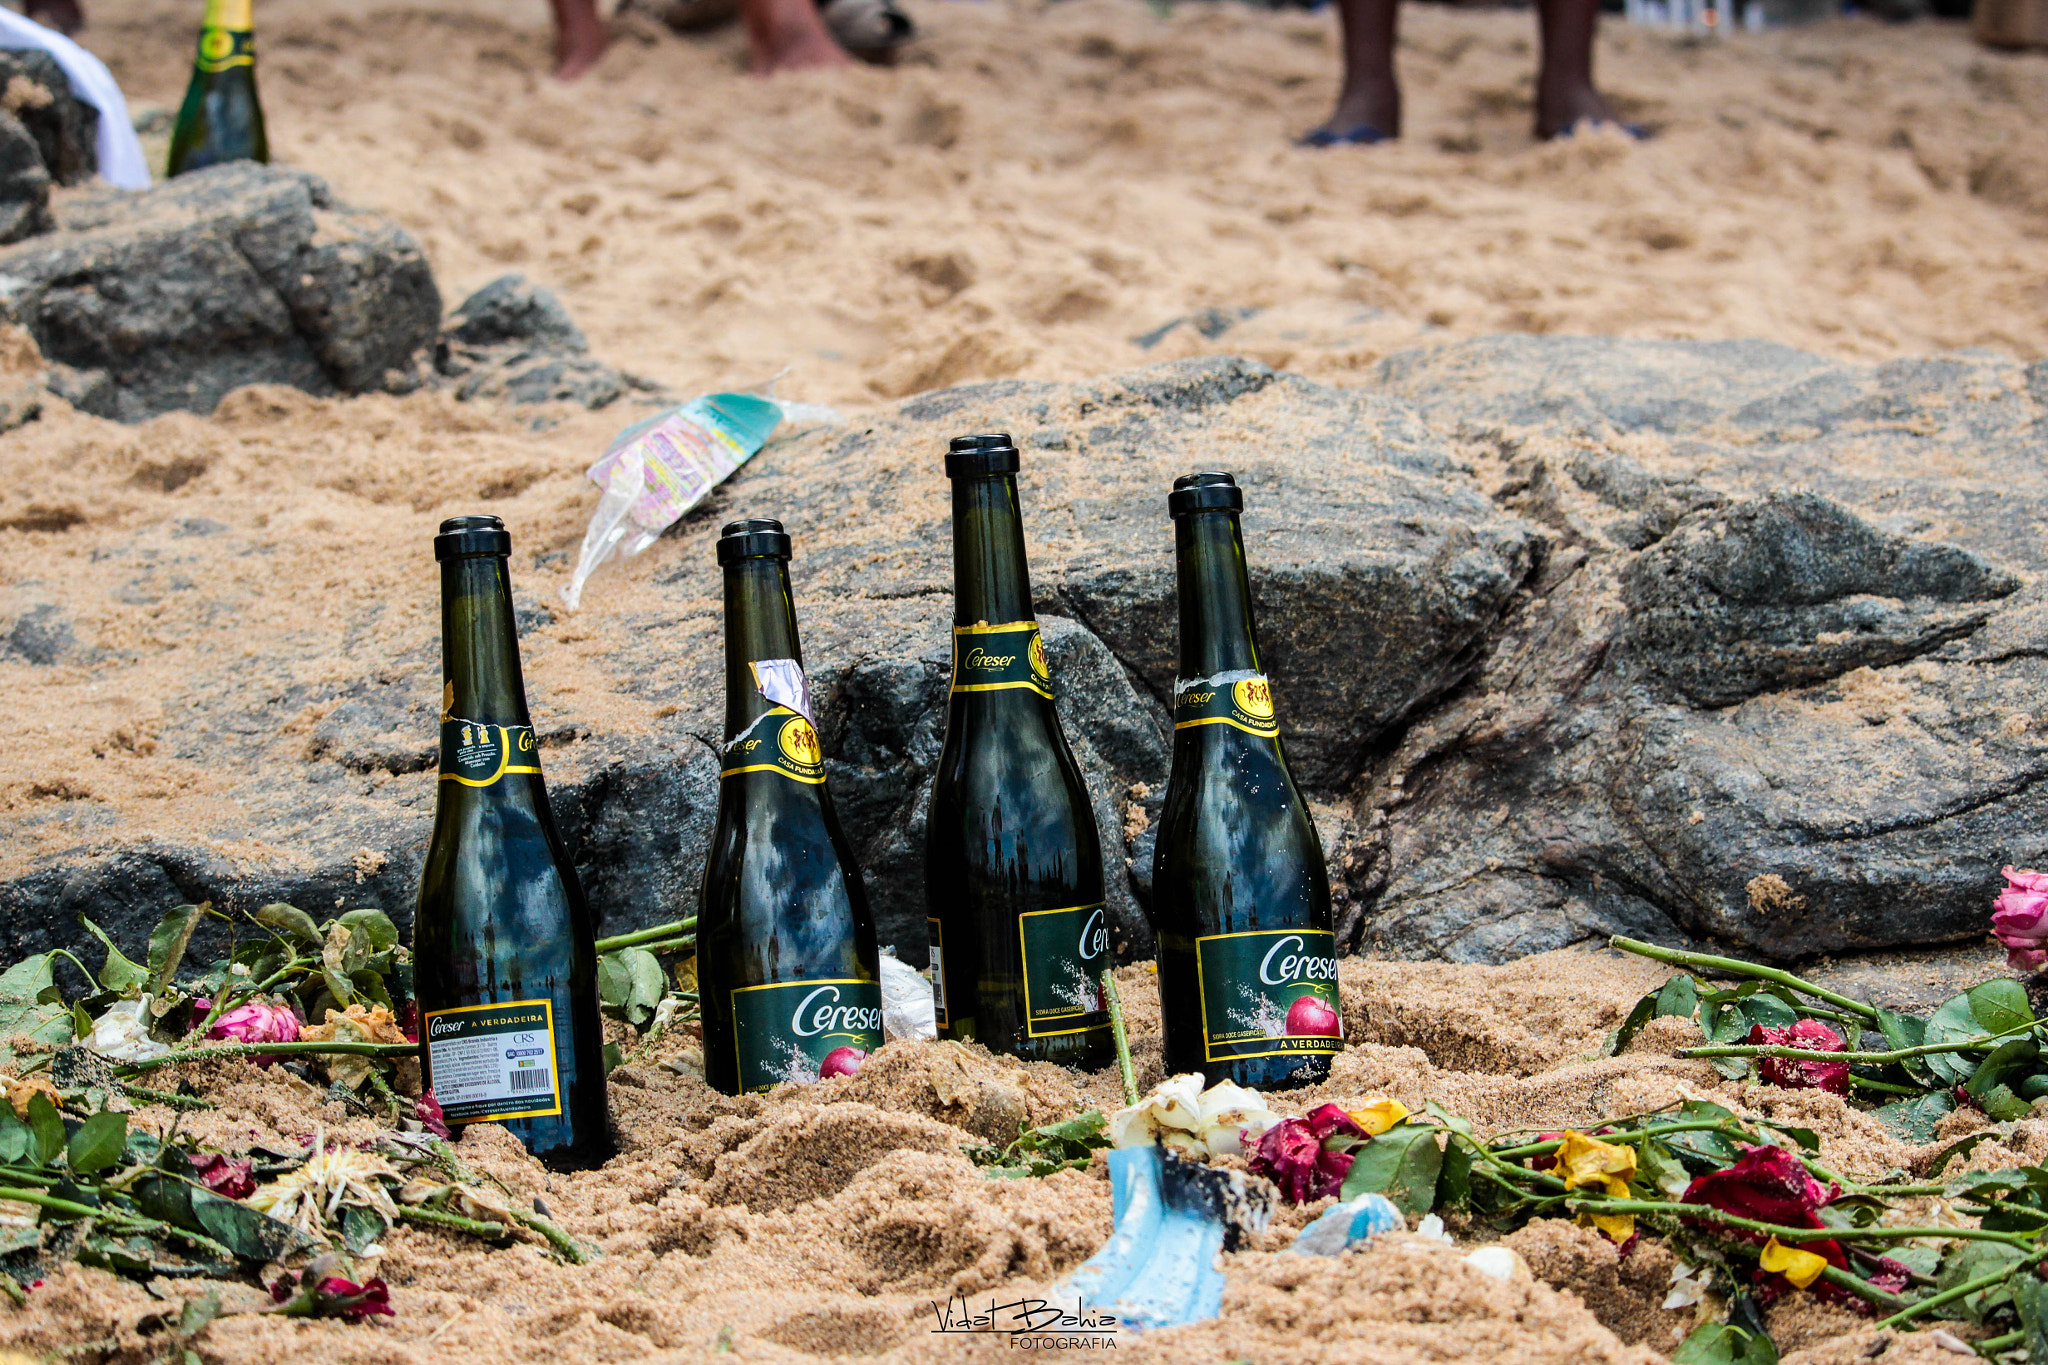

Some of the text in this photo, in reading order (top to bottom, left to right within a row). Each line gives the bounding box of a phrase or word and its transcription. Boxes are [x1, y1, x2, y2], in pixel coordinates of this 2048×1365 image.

[965, 647, 1016, 670] Cereser
[1176, 688, 1216, 708] Cereser
[1232, 709, 1248, 723] CASA
[778, 757, 794, 770] CASA
[792, 986, 882, 1036] Cereser
[430, 1016, 464, 1037] Cereser
[480, 1014, 543, 1027] VERDADEIRA
[513, 1033, 535, 1046] CRS
[1226, 1031, 1237, 1039] DOCE
[1280, 1040, 1288, 1049] A
